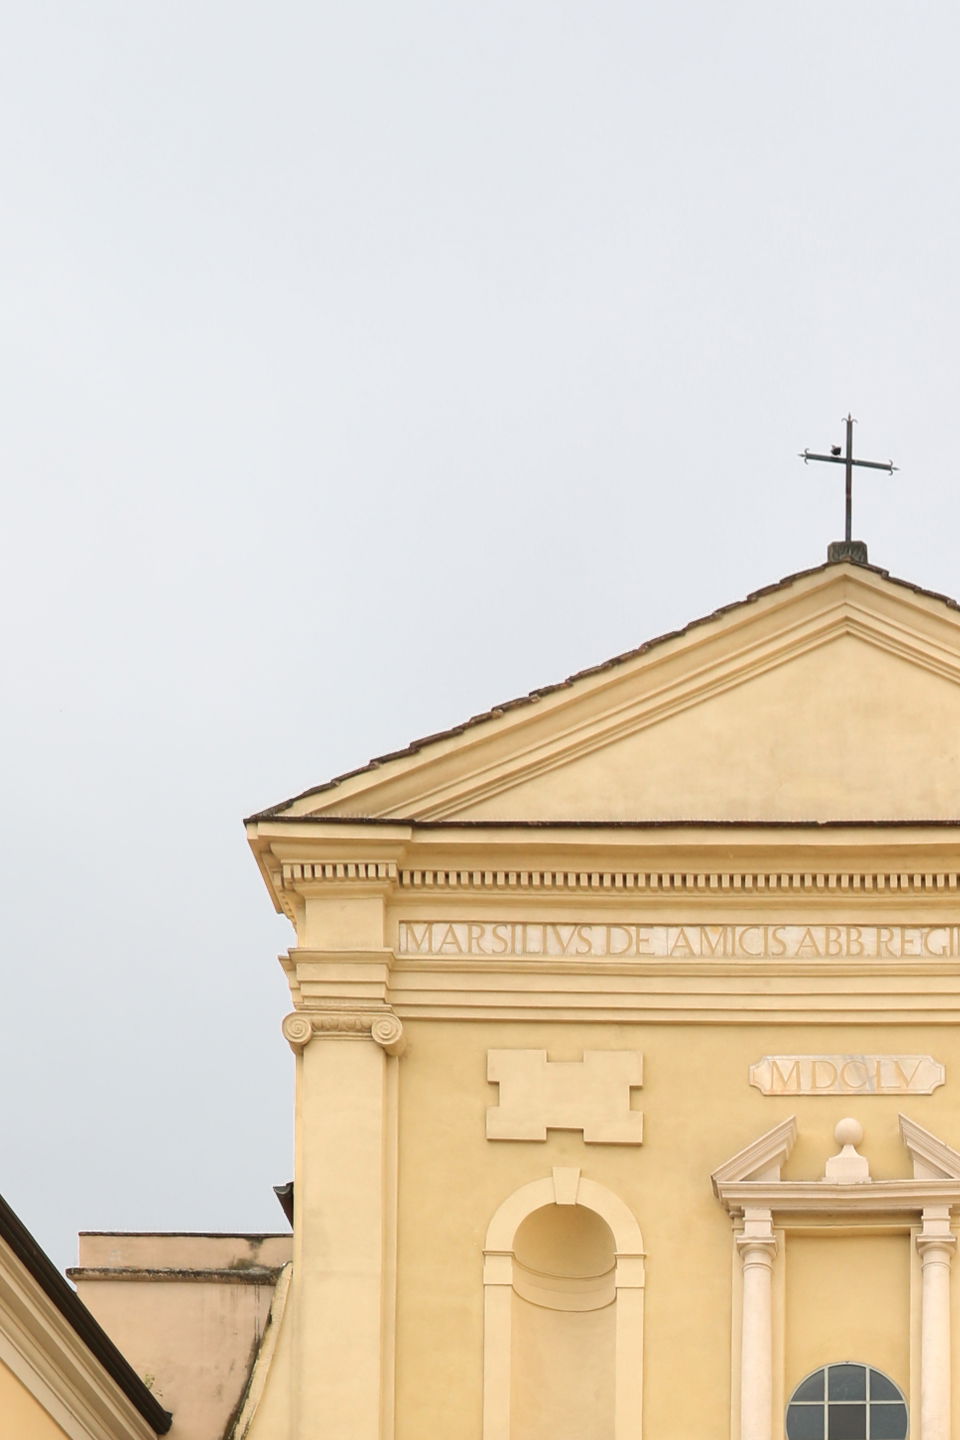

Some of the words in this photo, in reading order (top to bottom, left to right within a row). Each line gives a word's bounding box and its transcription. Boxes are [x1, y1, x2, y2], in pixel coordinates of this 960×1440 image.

[404, 922, 593, 955] MARSILIVS
[605, 924, 655, 956] DE
[669, 926, 787, 957] AMICIS
